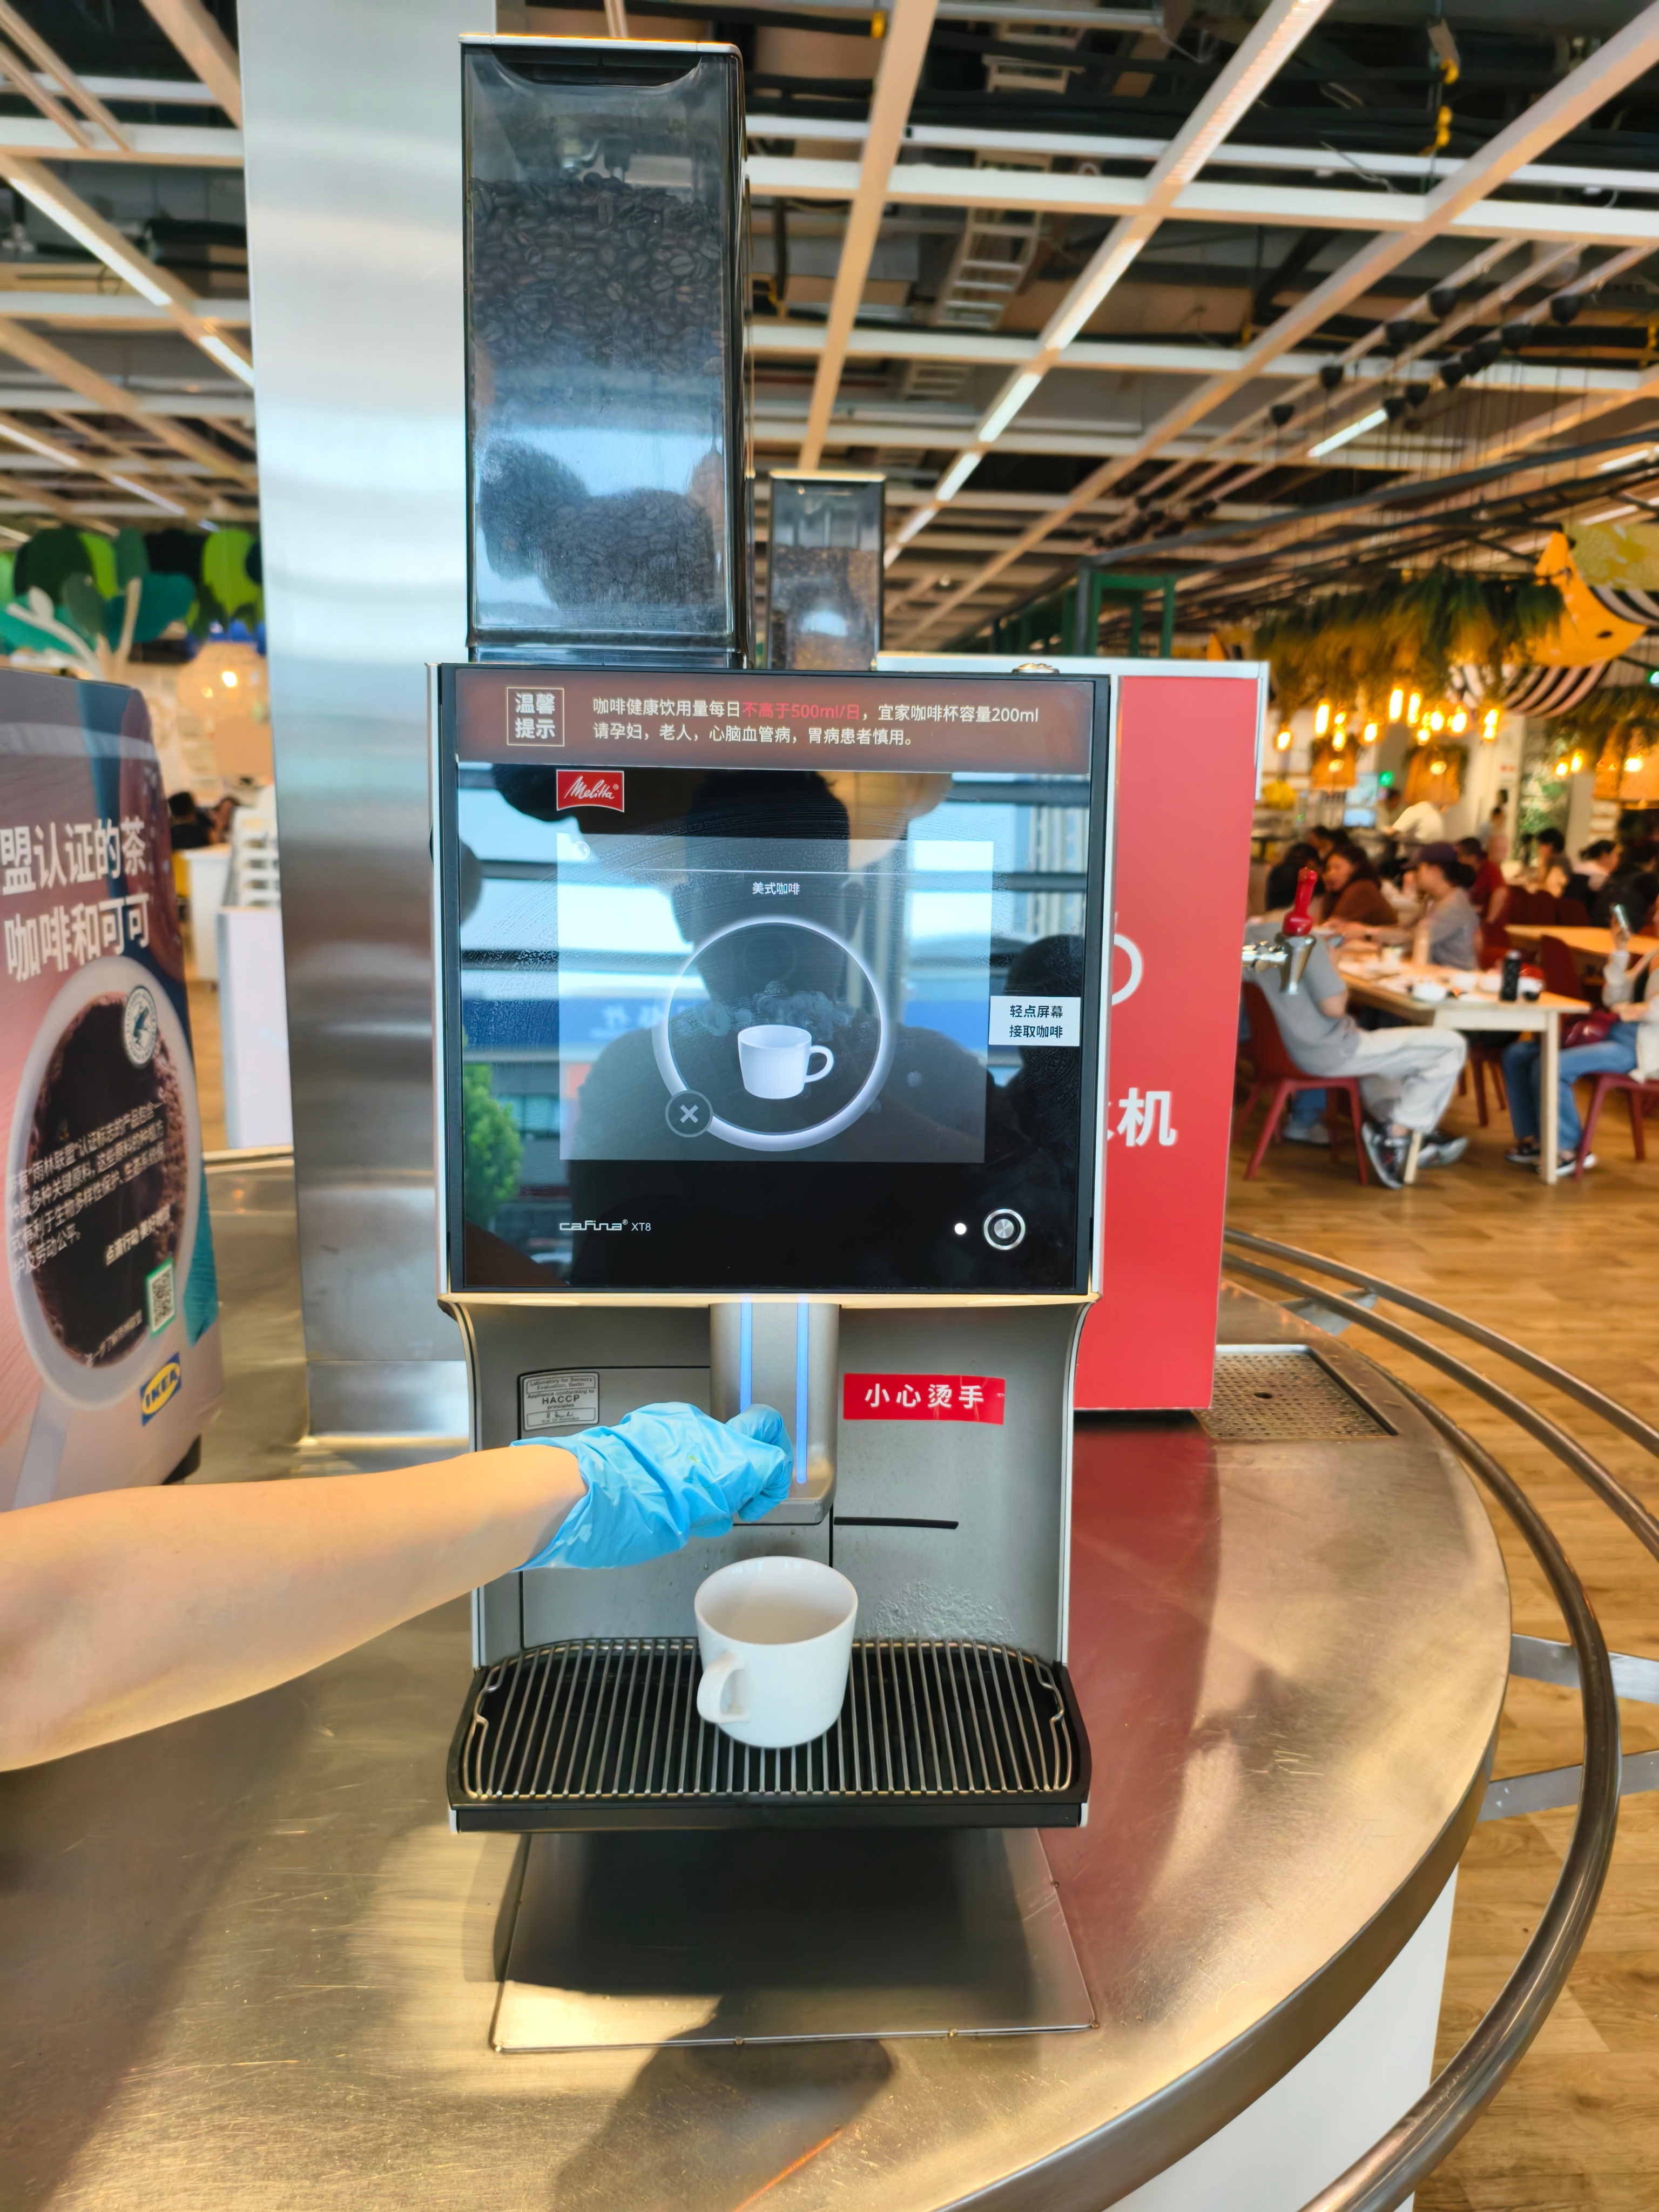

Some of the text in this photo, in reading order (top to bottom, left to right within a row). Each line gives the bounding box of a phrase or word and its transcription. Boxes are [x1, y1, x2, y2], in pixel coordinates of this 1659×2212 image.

[515, 691, 556, 714] 温馨
[515, 718, 556, 739] 提示
[752, 881, 800, 896] 美式咖啡
[4, 893, 150, 982] 咖啡和可可
[1009, 1004, 1064, 1019] 轻点屏幕
[1009, 1024, 1063, 1039] 接取咖啡
[1107, 1087, 1178, 1147] 机
[631, 1222, 651, 1231] XT8
[144, 1368, 178, 1410] IKEA
[542, 1394, 580, 1405] HACCP
[864, 1383, 984, 1408] 小心烫手
